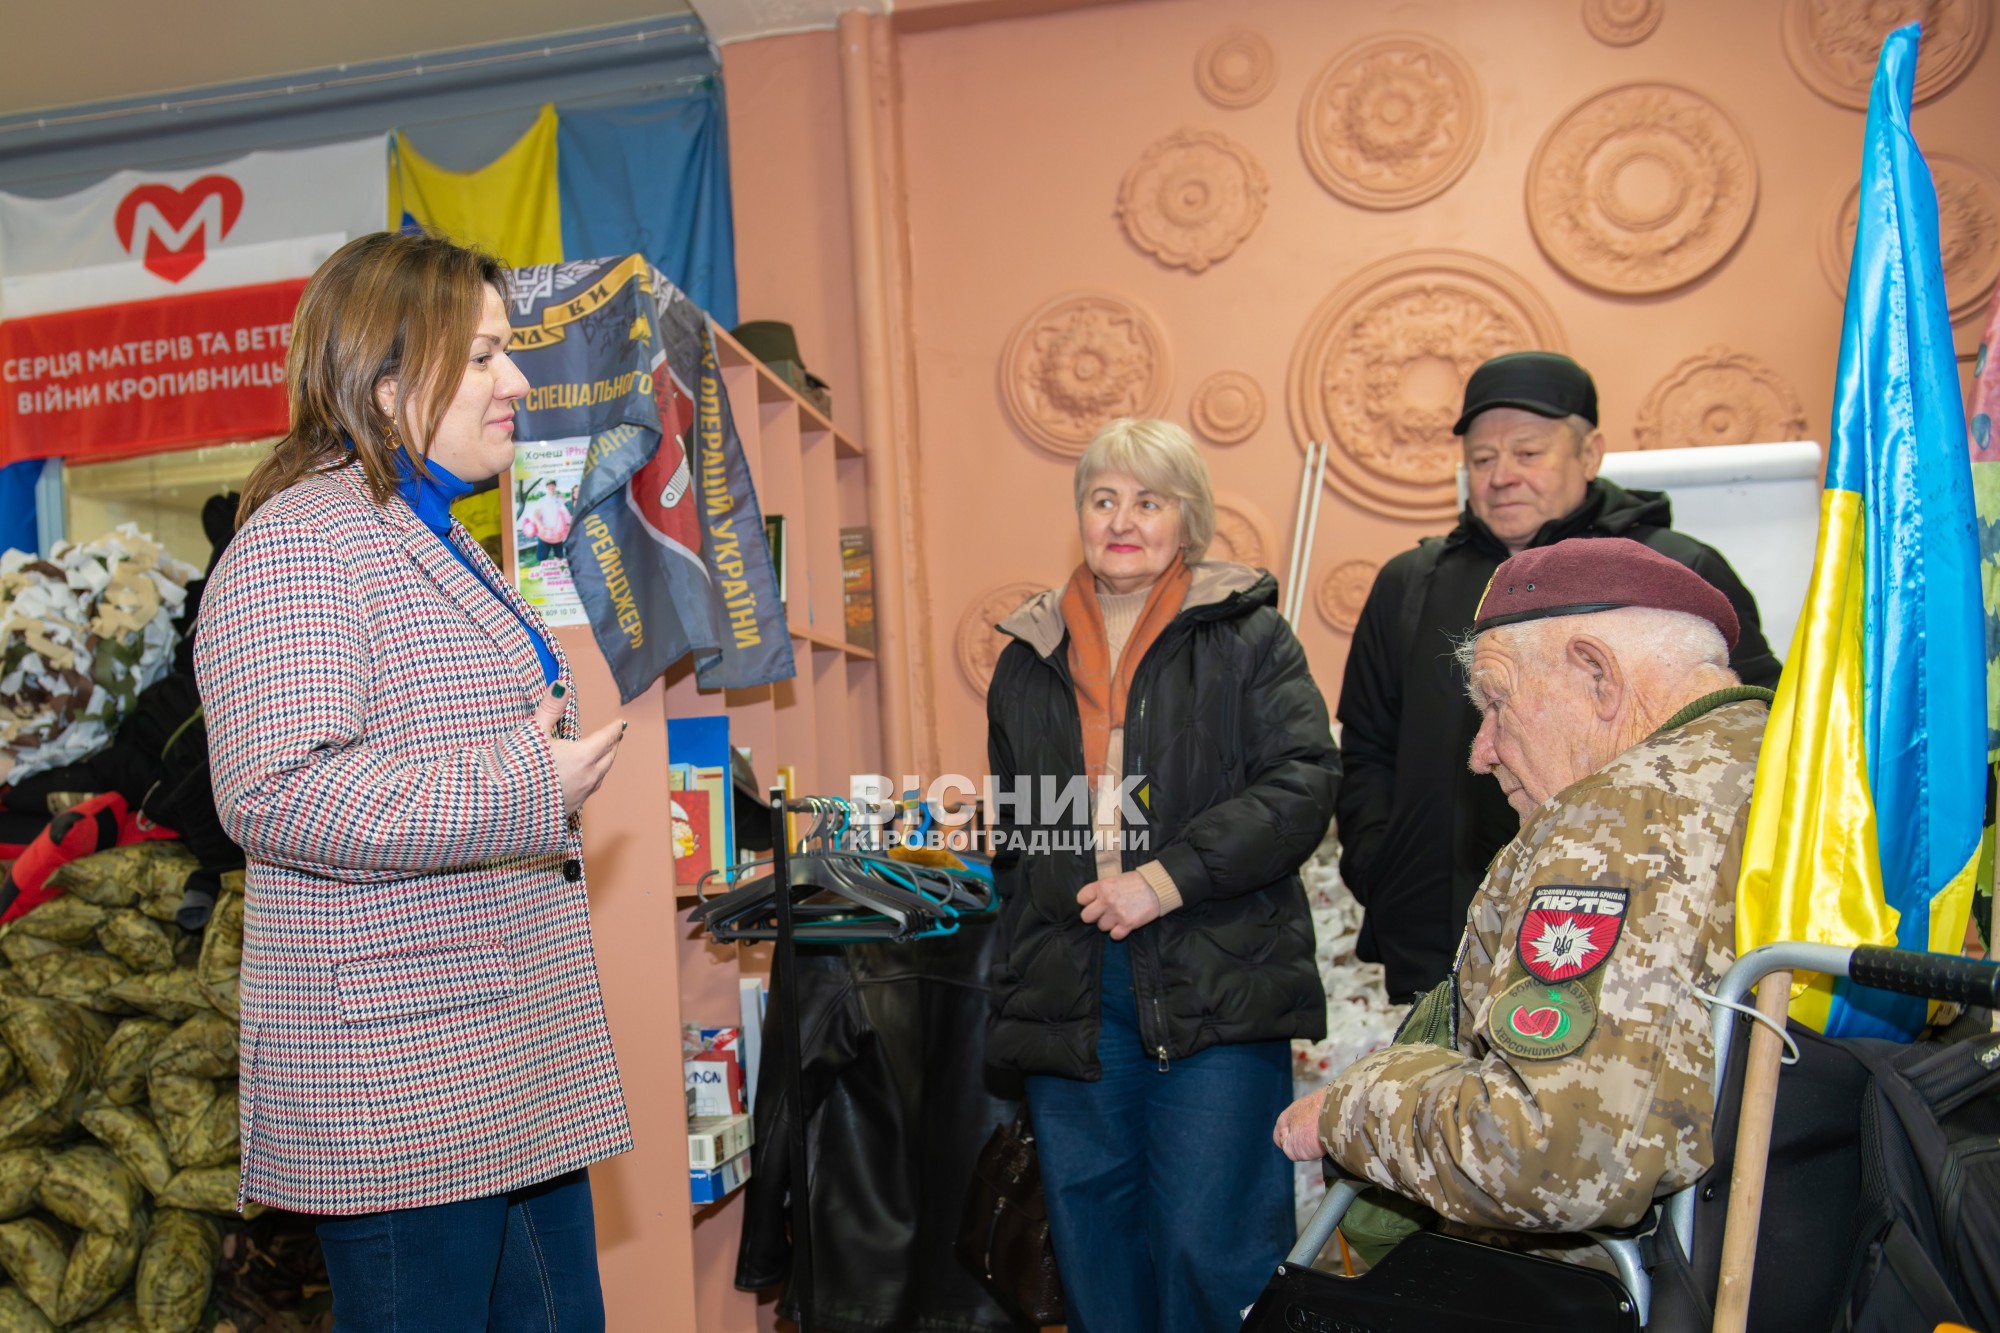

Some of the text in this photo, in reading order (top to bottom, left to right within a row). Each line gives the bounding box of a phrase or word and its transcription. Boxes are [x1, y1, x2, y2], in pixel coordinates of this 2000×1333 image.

[3, 323, 292, 382] СЕРЦЯ МАТЕРІВ ТА ВЕТЕ
[17, 361, 284, 414] ВІЙНИ КРОПИВНИЦЬ
[525, 370, 653, 411] СПЕЦІАЛЬНОГО
[525, 447, 588, 460] Хочеш iPho
[700, 376, 762, 650] ОПЕРАЦІЙ УКРАЇНИ
[1531, 895, 1624, 916] ЛЮТЬ
[1509, 980, 1541, 997] БОЙО
